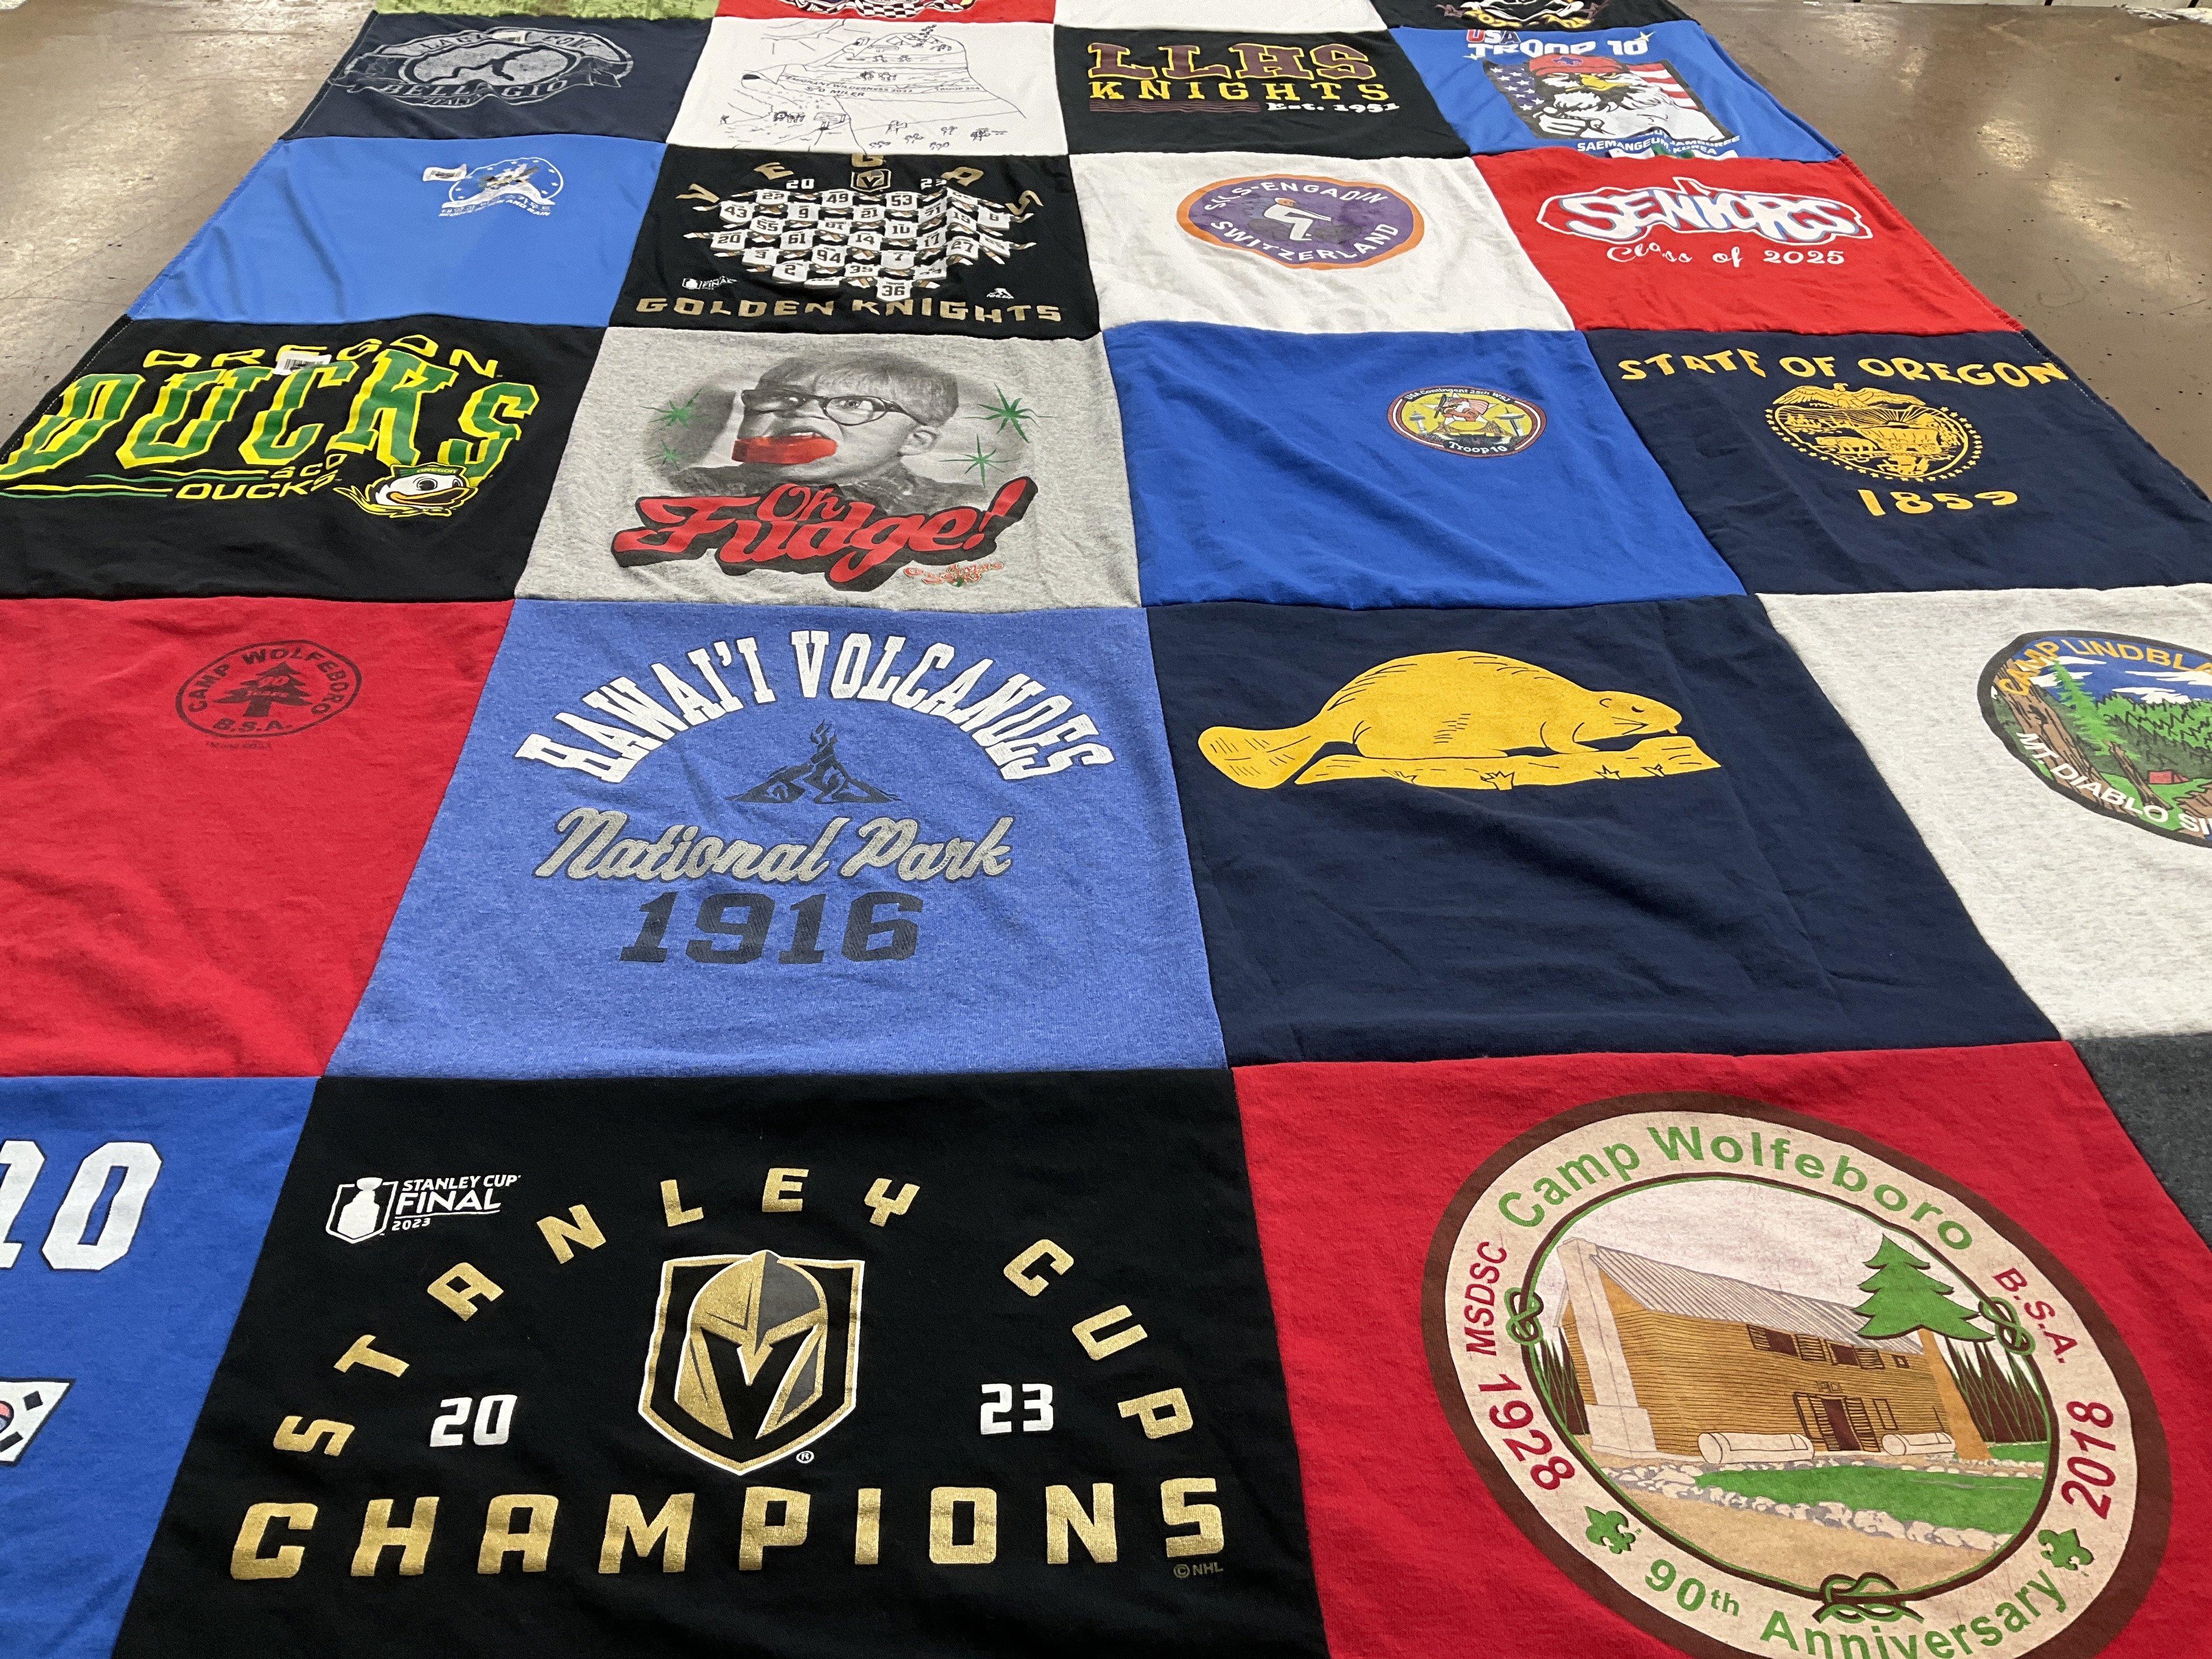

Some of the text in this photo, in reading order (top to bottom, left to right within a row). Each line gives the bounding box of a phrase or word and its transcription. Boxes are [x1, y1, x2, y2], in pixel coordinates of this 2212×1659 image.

[1466, 29, 1522, 44] USA
[1468, 40, 1649, 58] TROOP 10
[1088, 43, 1376, 80] LLHS
[1089, 80, 1390, 101] KNIGHTS
[1334, 103, 1401, 112] 1951
[1673, 145, 1717, 155] KOREA
[786, 178, 815, 189] 20
[1204, 182, 1389, 211] SILS-ENGADIN
[724, 206, 747, 218] 43
[826, 194, 849, 204] 49
[891, 195, 912, 206] 53
[757, 219, 779, 232] 55
[799, 208, 809, 218] 9
[861, 209, 878, 218] 21
[1557, 185, 1862, 242] SENIORS
[718, 234, 741, 245] 20
[788, 233, 806, 244] 61
[855, 234, 874, 245] 14
[924, 233, 939, 247] 17
[951, 241, 974, 253] 27
[1210, 220, 1399, 262] SWITZERLAND
[816, 250, 841, 263] 94
[894, 253, 904, 261] 7
[1607, 242, 1844, 268] Class of 2025
[785, 265, 795, 276] 2
[882, 285, 905, 296] 36
[636, 297, 1062, 323] GOLDEN KNIGHTS
[1618, 347, 2069, 388] STATE OF OREGON
[1404, 392, 1421, 400] USA
[0, 348, 540, 487] DUCKS
[1449, 441, 1489, 454] Troop
[175, 469, 339, 500] DUCKS
[757, 483, 849, 522] Oh
[1858, 488, 2019, 517] 1859
[612, 477, 1034, 587] Fudge!
[188, 647, 349, 714] CAMP WOLFEBORO
[1999, 641, 2061, 696] CAMP
[791, 630, 1116, 781] VOLCANOES
[2016, 732, 2059, 765] MT.
[2050, 763, 2169, 823] DIABLO
[534, 806, 1014, 882] National Park
[619, 891, 925, 965] 1916
[402, 1175, 518, 1192] STANLEY CUP
[1498, 1126, 1973, 1250] Camp Wolfeboro
[395, 1187, 501, 1215] FINAL
[391, 1217, 431, 1231] 2023
[273, 1167, 1194, 1456] STANLEY CUP
[1464, 1241, 1508, 1357] MSDSC
[1993, 1267, 2078, 1364] B.S.A.
[430, 1393, 517, 1447] 20
[980, 1383, 1054, 1435] 23
[1477, 1373, 1576, 1491] 1928
[2061, 1401, 2117, 1520] 2018
[230, 1477, 1224, 1580] CHAMPIONS
[1645, 1559, 2068, 1659] 90th Anniversary
